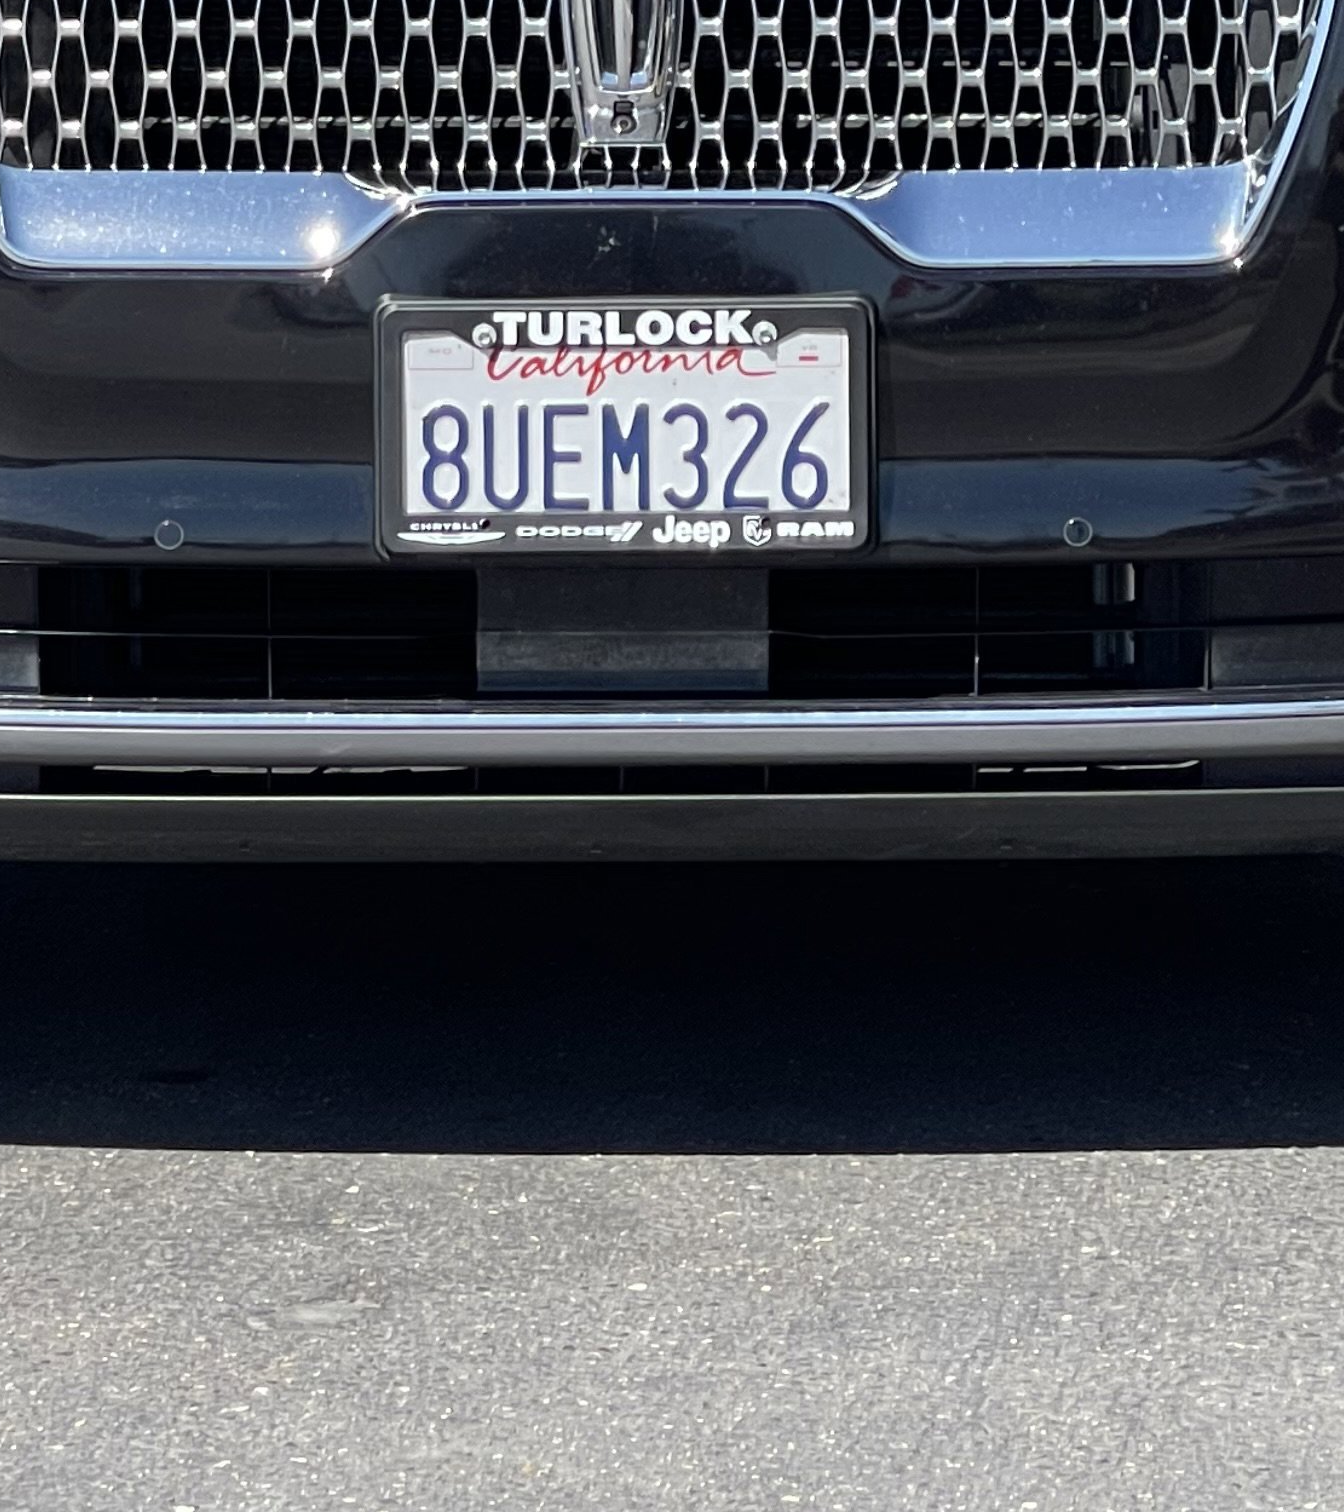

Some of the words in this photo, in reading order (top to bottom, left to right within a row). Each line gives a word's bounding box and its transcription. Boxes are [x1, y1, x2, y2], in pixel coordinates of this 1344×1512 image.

[493, 309, 752, 347] TURLOCK
[485, 345, 776, 396] California
[421, 401, 831, 512] 8UEM326
[409, 522, 482, 531] CHRYSL
[516, 525, 621, 538] DODGE
[652, 514, 731, 549] Jeep
[776, 520, 855, 537] RAM
